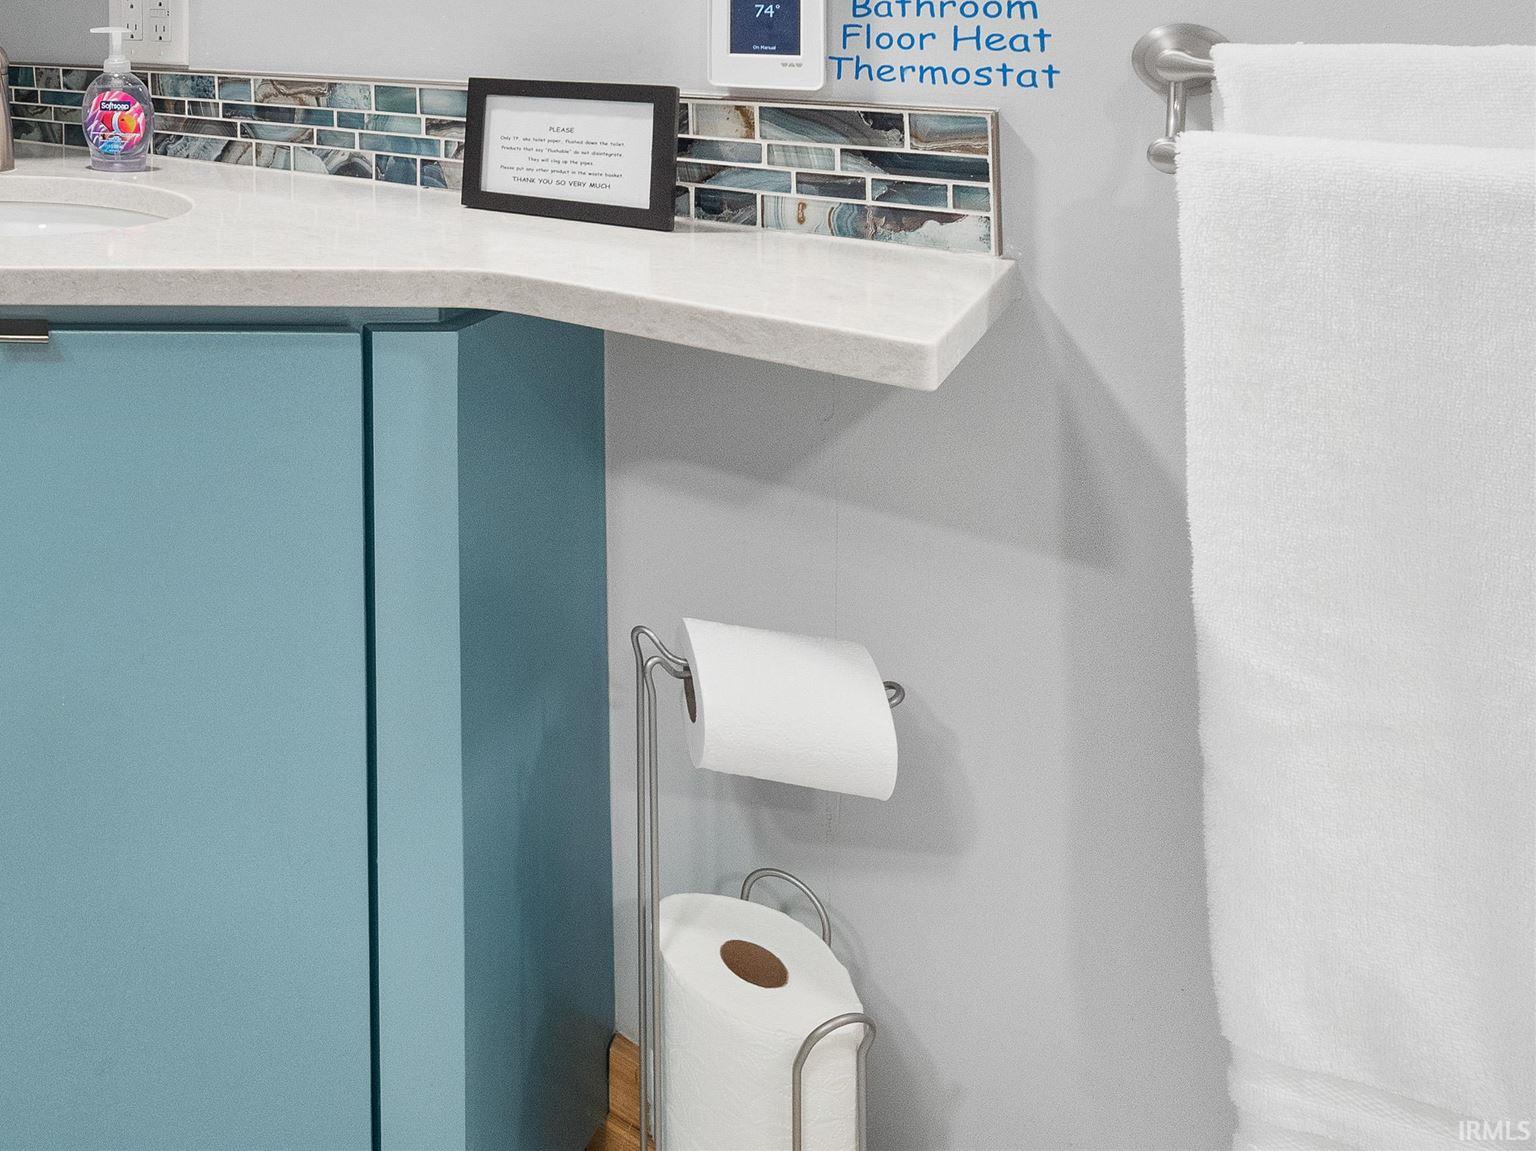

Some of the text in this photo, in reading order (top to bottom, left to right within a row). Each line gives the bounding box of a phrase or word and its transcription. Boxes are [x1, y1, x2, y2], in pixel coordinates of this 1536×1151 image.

[754, 4, 781, 18] 74°
[842, 23, 1052, 53] Floor Heat
[828, 55, 1061, 89] Thermostat
[101, 101, 130, 110] Softsoap
[512, 176, 536, 184] THANK
